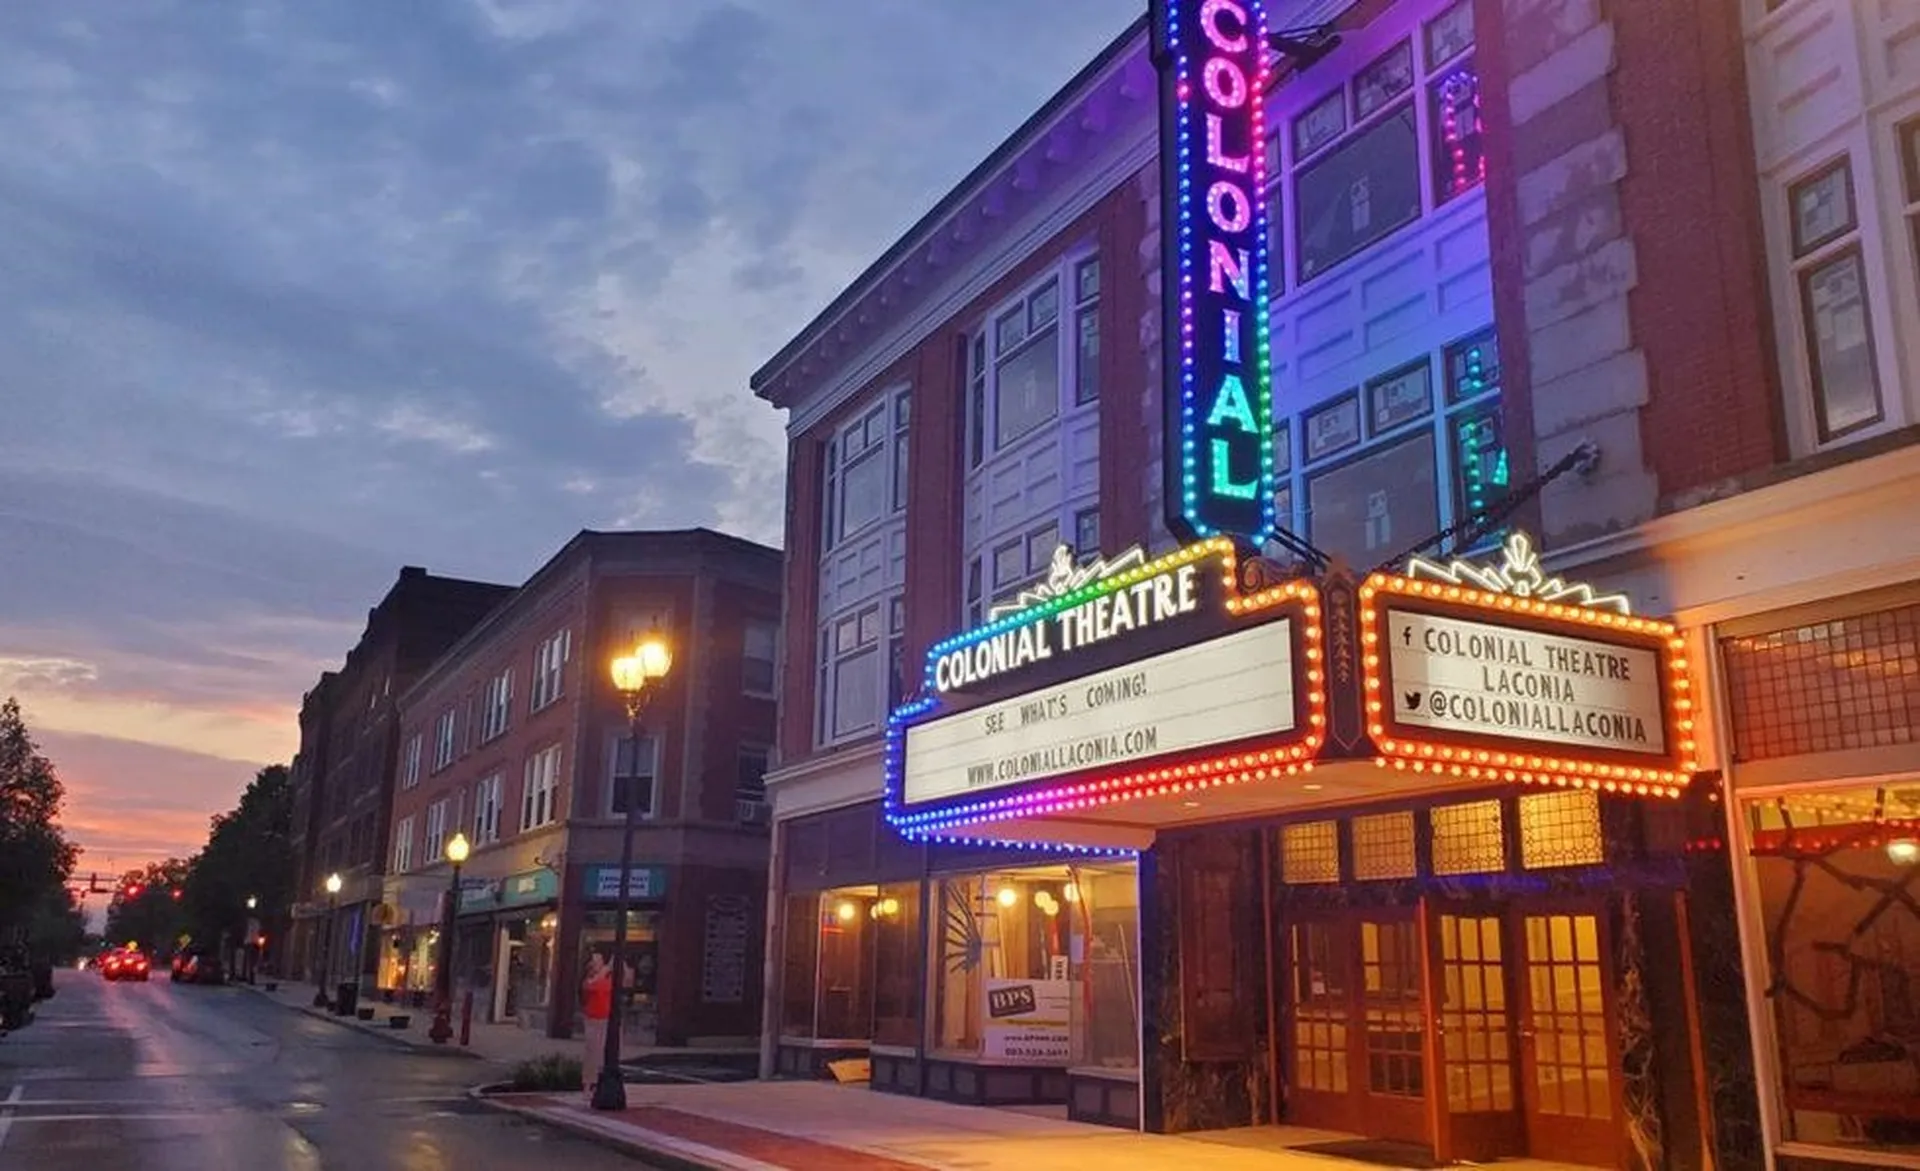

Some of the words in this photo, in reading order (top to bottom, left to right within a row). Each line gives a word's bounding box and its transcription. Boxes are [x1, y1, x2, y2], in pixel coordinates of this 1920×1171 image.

[1200, 0, 1258, 500] COLONIAL
[935, 618, 1052, 693] COLONIAL
[1056, 564, 1198, 651] THEATRE
[1424, 627, 1533, 666] COLONIAL
[1544, 645, 1631, 681] THEATRE
[984, 711, 1005, 736] SEE
[1020, 694, 1068, 727] WHAT'S
[1086, 671, 1148, 708] COMING!
[1481, 665, 1575, 702] LACONIA
[1428, 689, 1647, 742] @COLONIALLACONIA
[967, 726, 1157, 786] WWW.COLONIALLACONIA.COM
[991, 987, 1032, 1009] BPS
